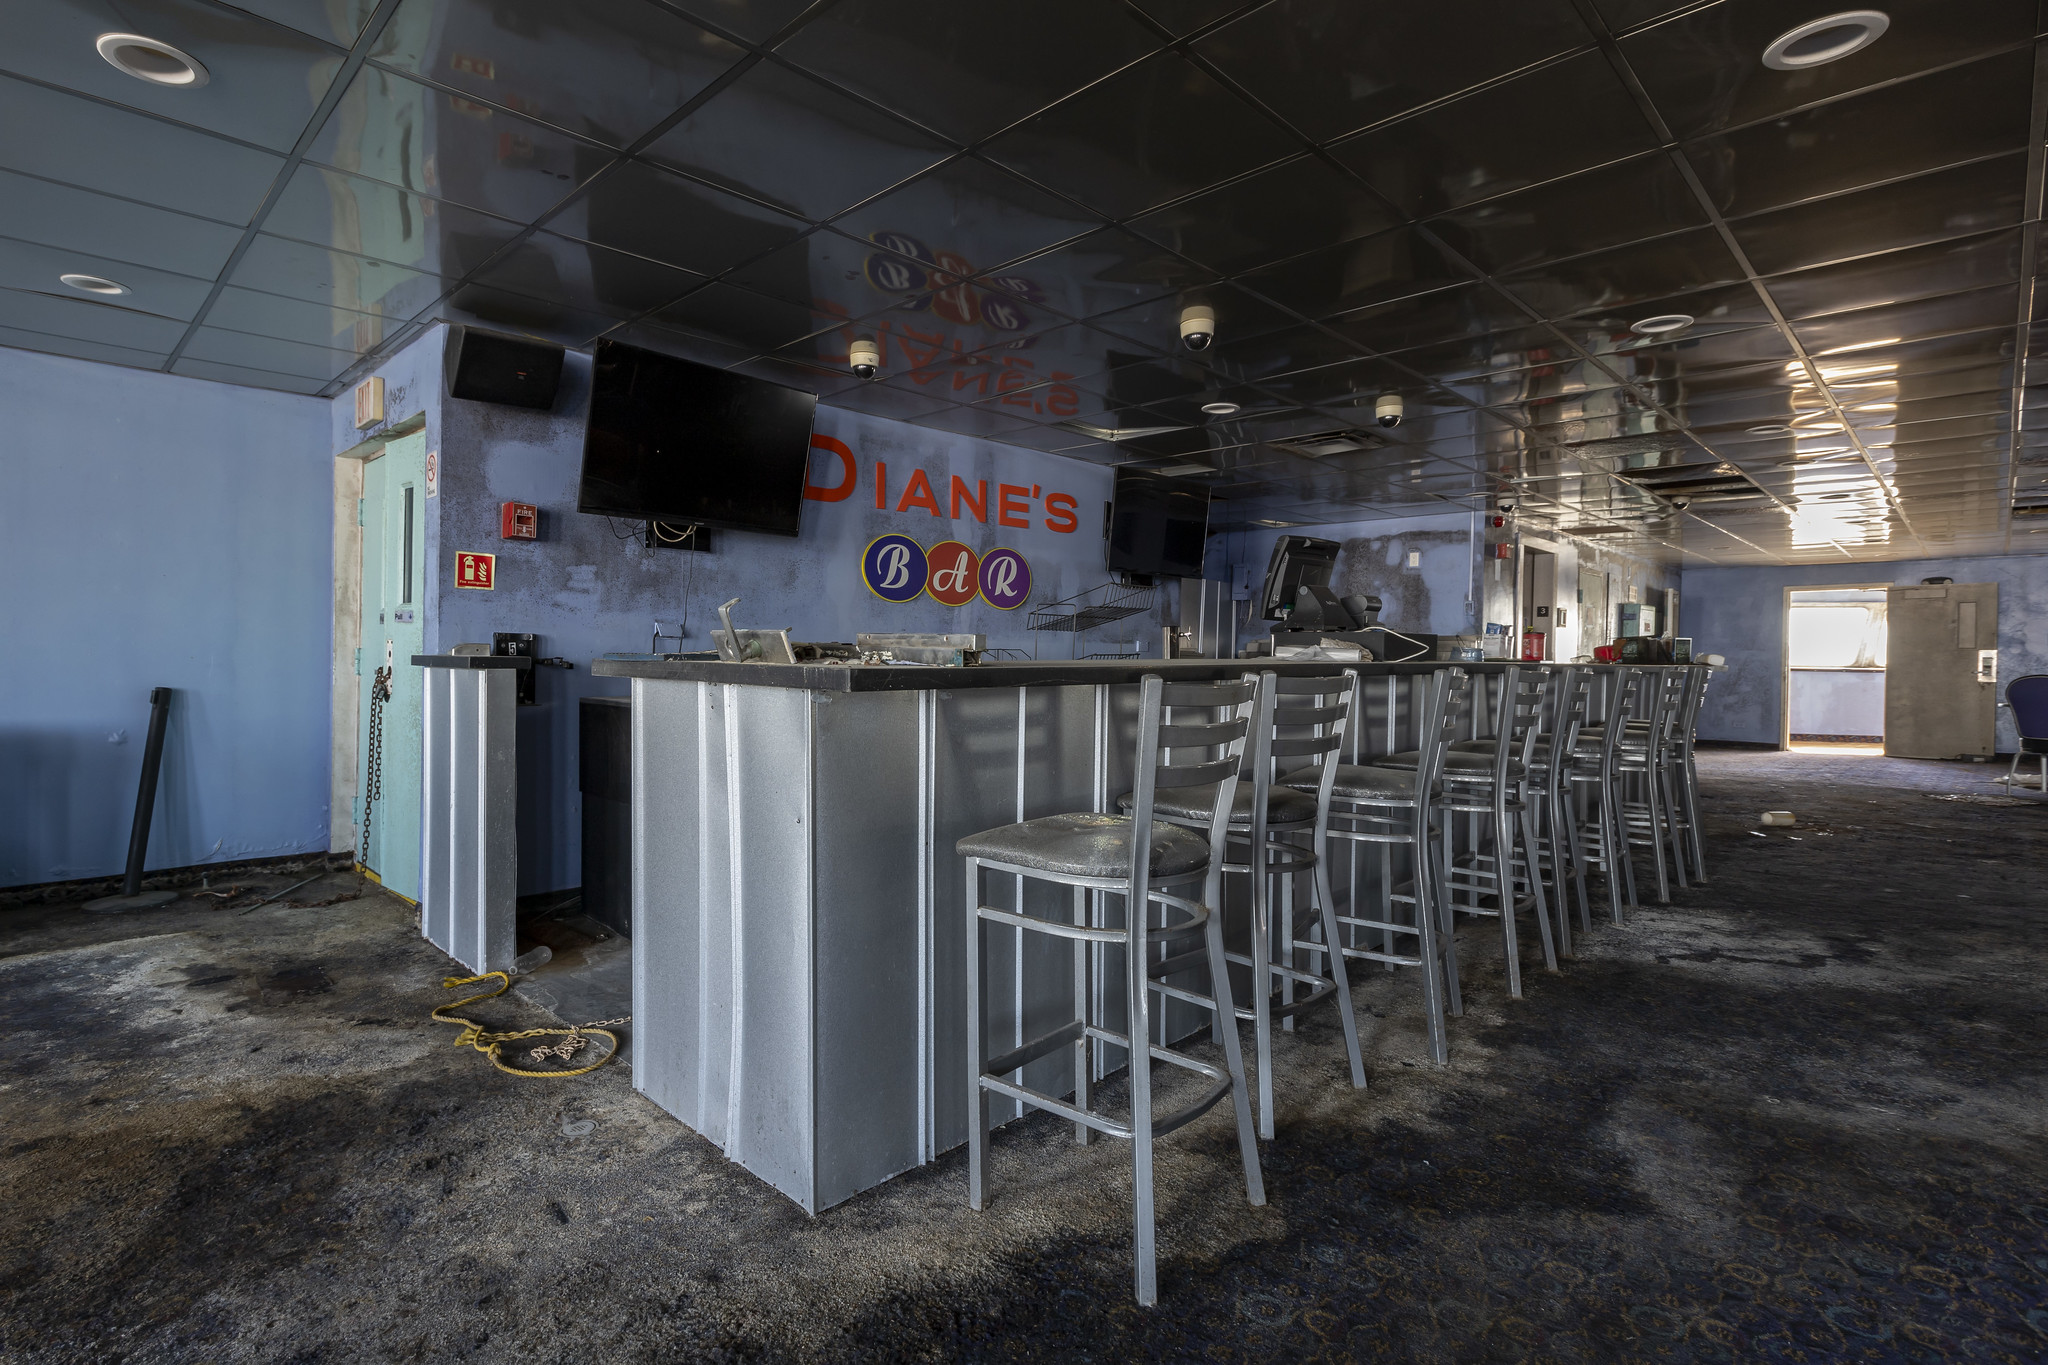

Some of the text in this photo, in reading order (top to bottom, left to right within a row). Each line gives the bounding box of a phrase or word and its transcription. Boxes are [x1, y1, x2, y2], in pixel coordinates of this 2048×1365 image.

[357, 381, 371, 424] EXIT
[803, 433, 1078, 534] DIANE'S
[877, 543, 1018, 597] BAR
